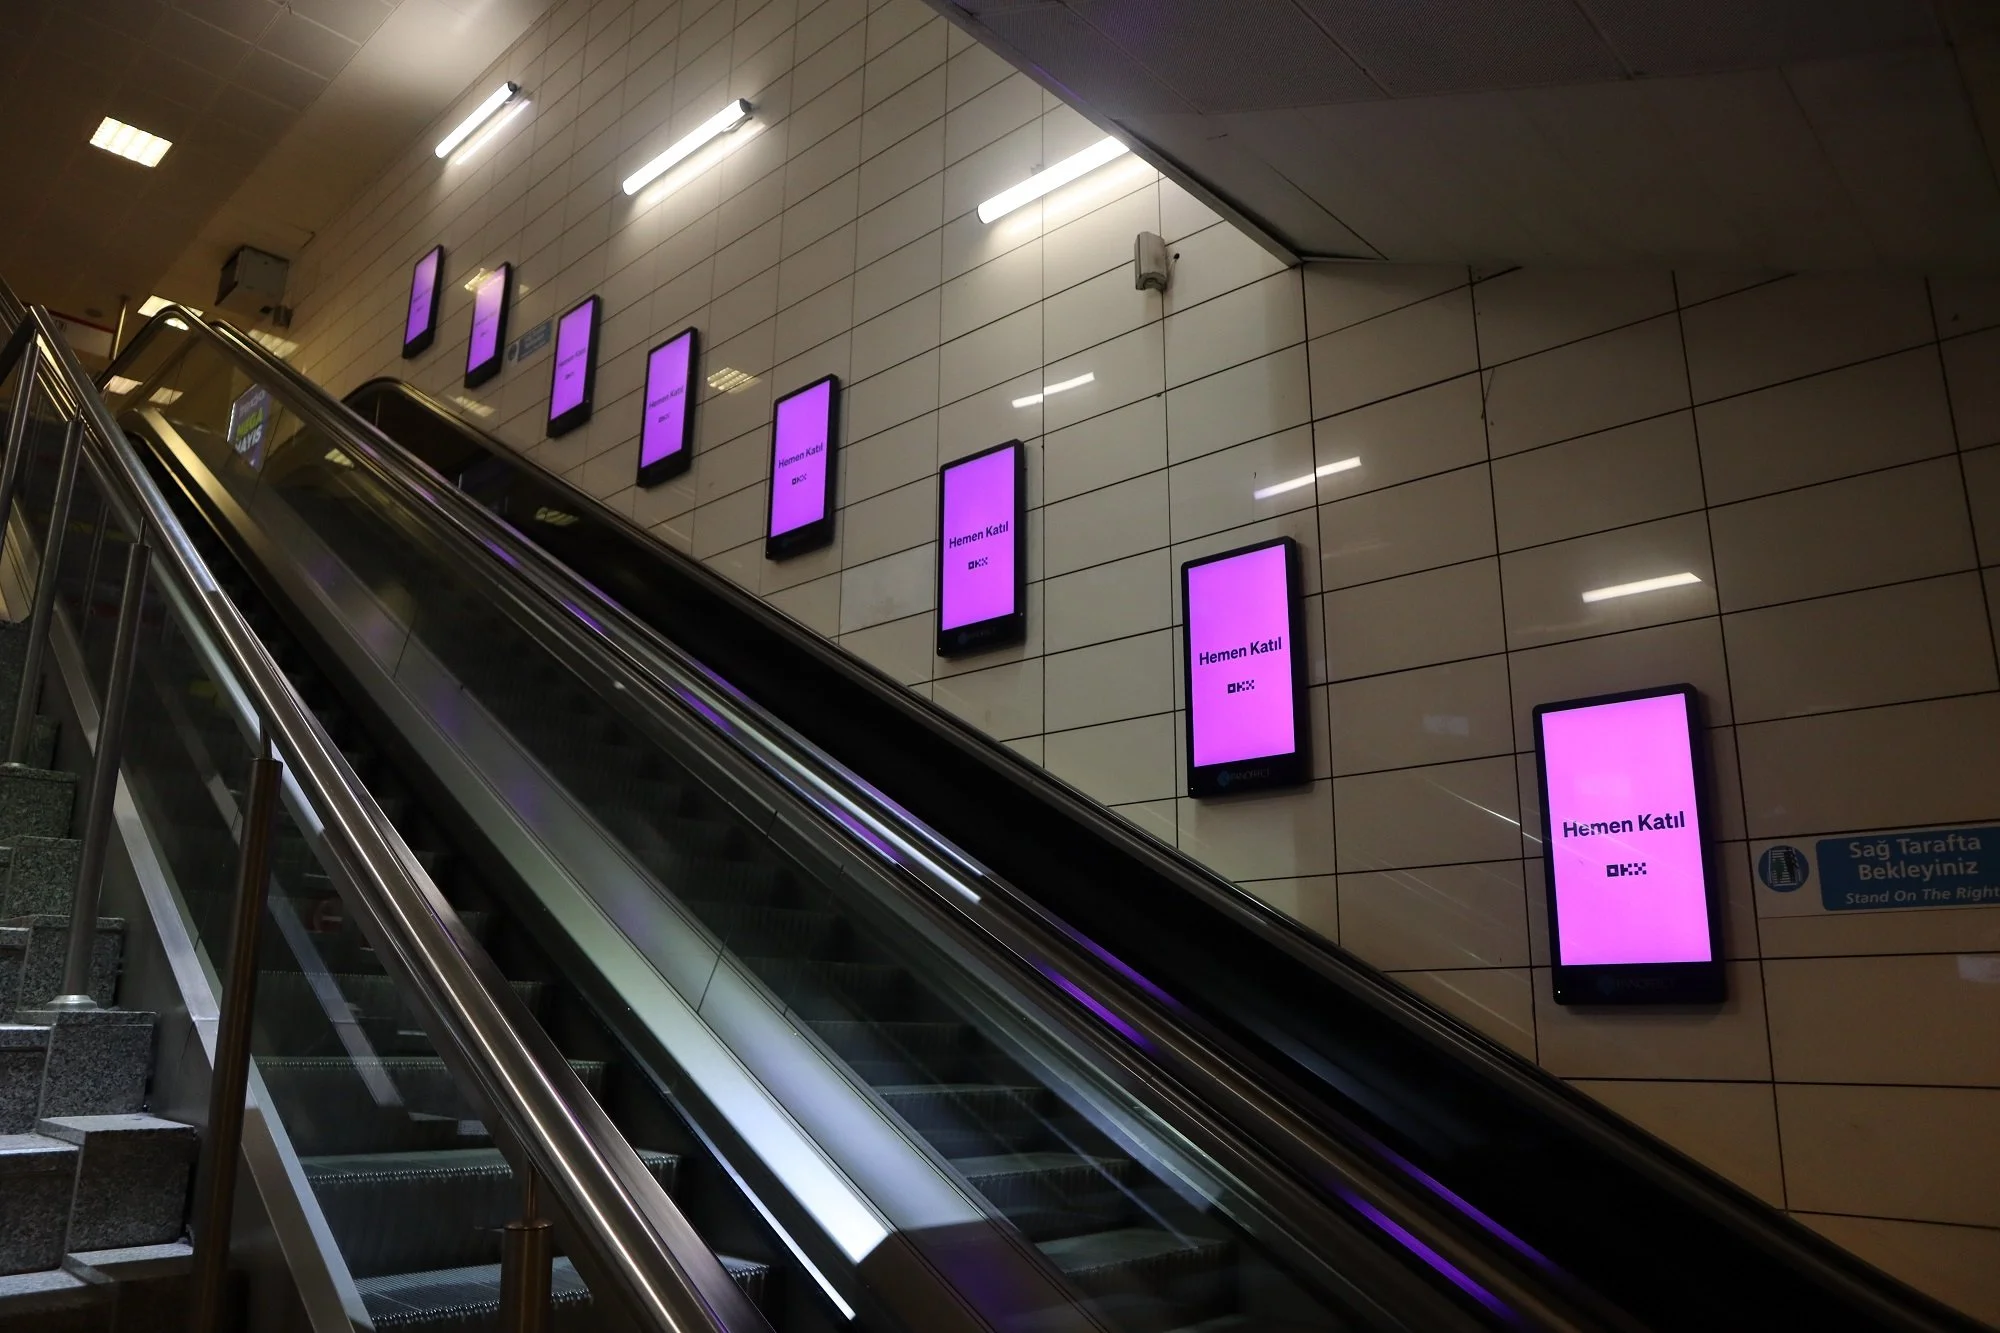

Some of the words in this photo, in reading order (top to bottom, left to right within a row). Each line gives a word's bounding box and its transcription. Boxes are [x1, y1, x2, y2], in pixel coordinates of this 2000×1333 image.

[778, 452, 805, 468] Hemen
[949, 531, 984, 548] Hemen
[985, 520, 1009, 537] Katıl
[1199, 646, 1247, 666] Hemen
[1250, 636, 1282, 655] Katıl
[1563, 819, 1633, 838] Hemen
[1637, 811, 1685, 832] Katıl
[1849, 840, 1891, 860] Sağ
[1896, 834, 1981, 855] Tarafta
[1606, 862, 1648, 878] OKX
[1858, 859, 1979, 882] Bekleyiniz
[1846, 890, 1889, 905] Stand
[1894, 890, 1917, 902] On
[1922, 887, 1951, 901] The
[1956, 885, 2000, 902] Right
